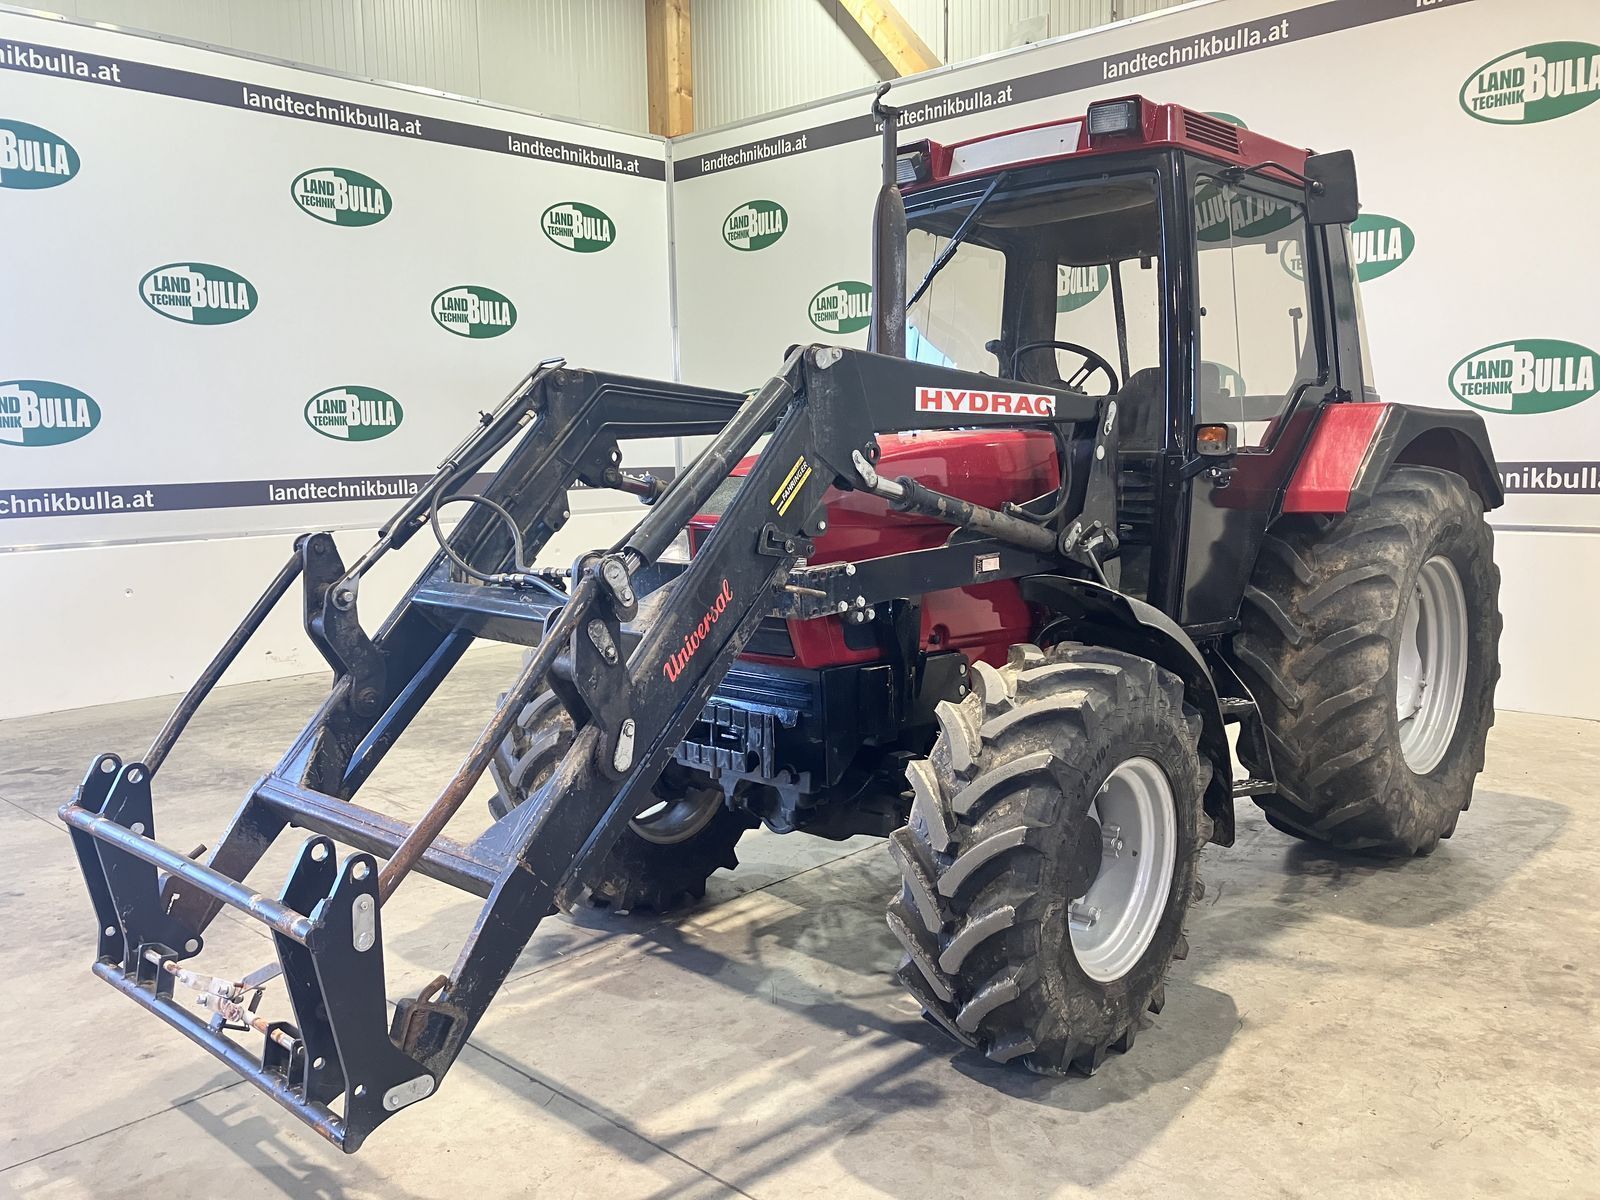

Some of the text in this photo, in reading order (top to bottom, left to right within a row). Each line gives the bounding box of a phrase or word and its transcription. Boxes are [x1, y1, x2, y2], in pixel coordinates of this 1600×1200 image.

[1103, 19, 1289, 80] landtechnikbulla.at
[1478, 66, 1525, 94] LAND
[242, 87, 422, 135] landtechnikbulla.at
[1471, 89, 1525, 112] TECHNIK
[0, 128, 70, 176] BULLA
[508, 135, 640, 173] landtechnikbulla.at
[701, 134, 807, 172] landtechnikbulla.at
[303, 177, 335, 196] LAND
[333, 176, 385, 215] BULLA
[300, 194, 336, 209] TECHNIK
[547, 225, 574, 238] TECHNIK
[550, 211, 573, 227] LAND
[572, 209, 611, 242] BULLA
[729, 214, 749, 231] LAND
[748, 208, 783, 238] BULLA
[727, 229, 750, 241] TECHNIK
[1352, 227, 1402, 264] ULLA
[153, 275, 191, 293] LAND
[190, 271, 250, 310] BULLA
[1057, 264, 1099, 297] BULLA
[150, 293, 192, 307] TECHNIK
[441, 296, 468, 312] LAND
[467, 293, 511, 326] BULLA
[816, 295, 838, 311] LAND
[438, 311, 469, 323] TECHNIK
[813, 311, 839, 322] TECHNIK
[1467, 359, 1513, 380] LAND
[1512, 350, 1595, 394] BULLA
[1460, 381, 1513, 396] TECHNIK
[19, 390, 91, 429] BULLA
[316, 399, 347, 414] LAND
[346, 394, 397, 426] BULLA
[920, 389, 1052, 416] HYDRAC
[313, 415, 348, 426] TECHNIK
[781, 461, 809, 501] FAHRINGER
[663, 578, 734, 682] Universal
